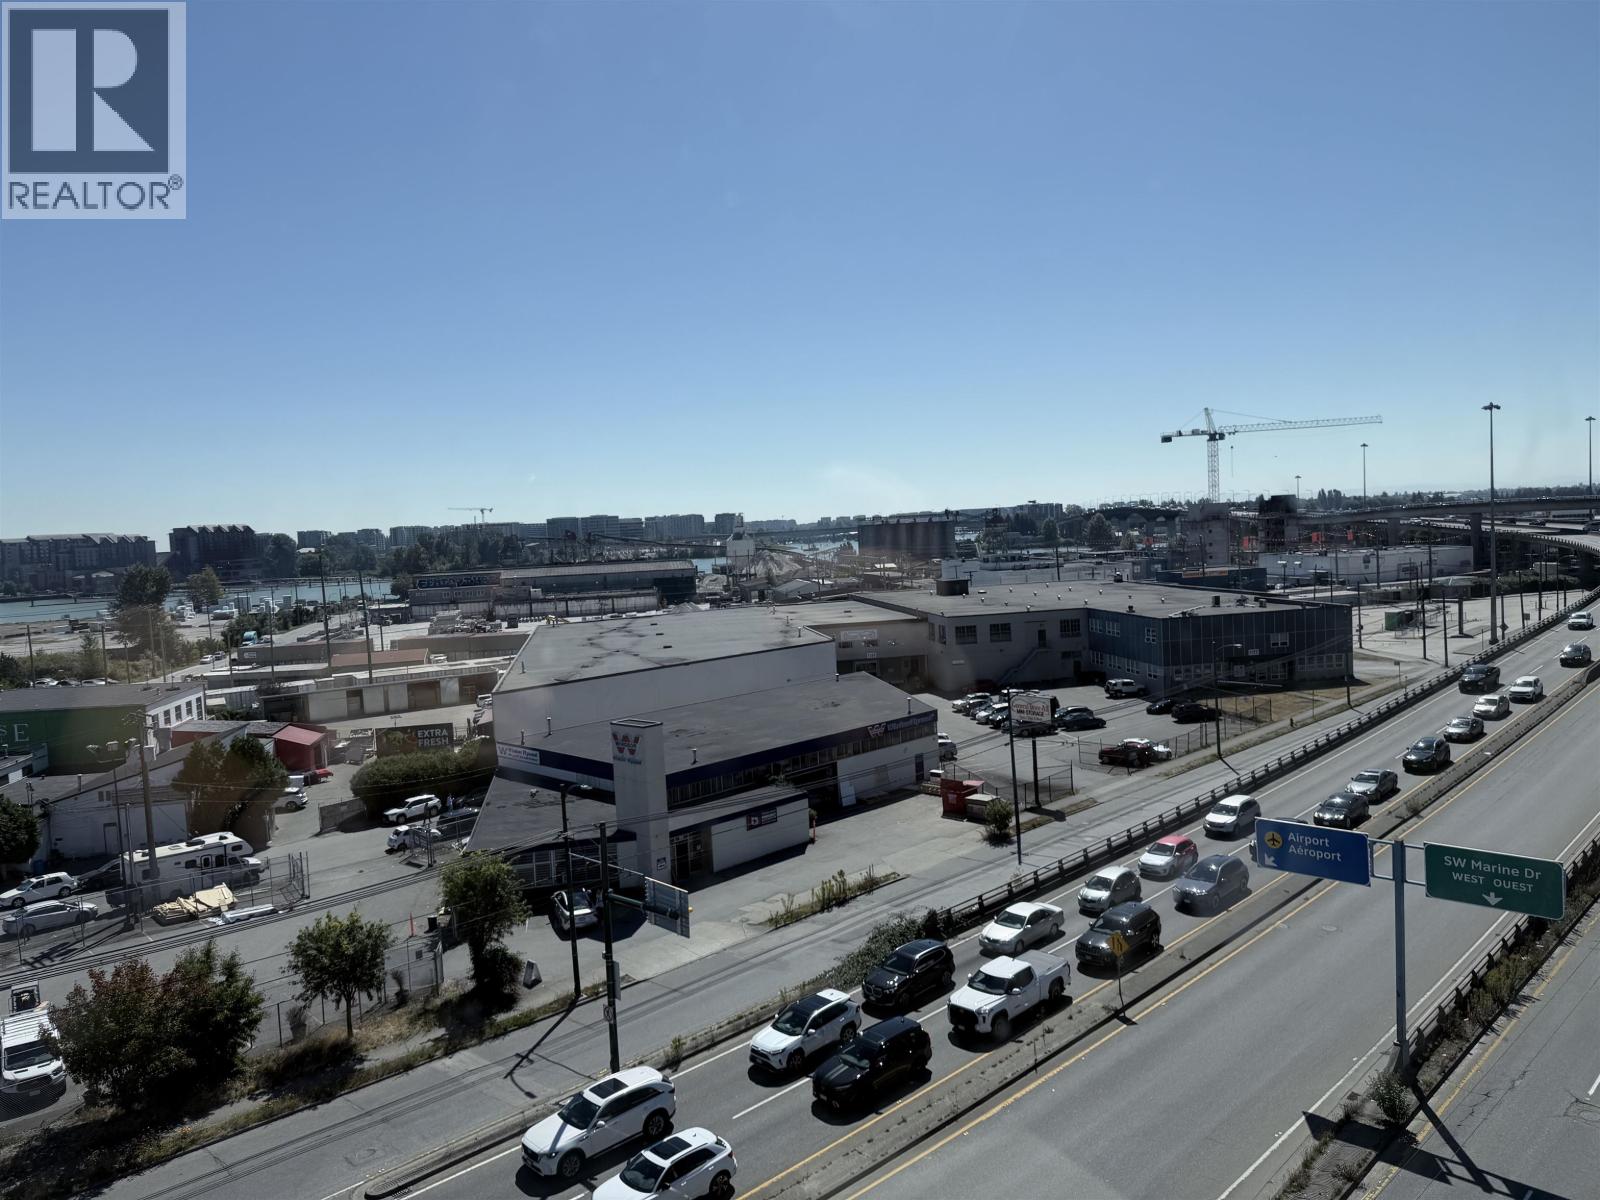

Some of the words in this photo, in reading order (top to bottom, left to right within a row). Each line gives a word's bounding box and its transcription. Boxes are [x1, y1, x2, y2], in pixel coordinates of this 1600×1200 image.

[417, 728, 449, 738] EXTRA
[418, 737, 449, 747] FRESH
[1288, 832, 1330, 847] Airport
[1288, 845, 1342, 862] Aéroport
[1444, 855, 1467, 869] SW
[1471, 859, 1520, 877] Marine
[1524, 868, 1541, 880] Dr
[1452, 871, 1485, 885] WEST
[1493, 879, 1534, 893] OUEST
